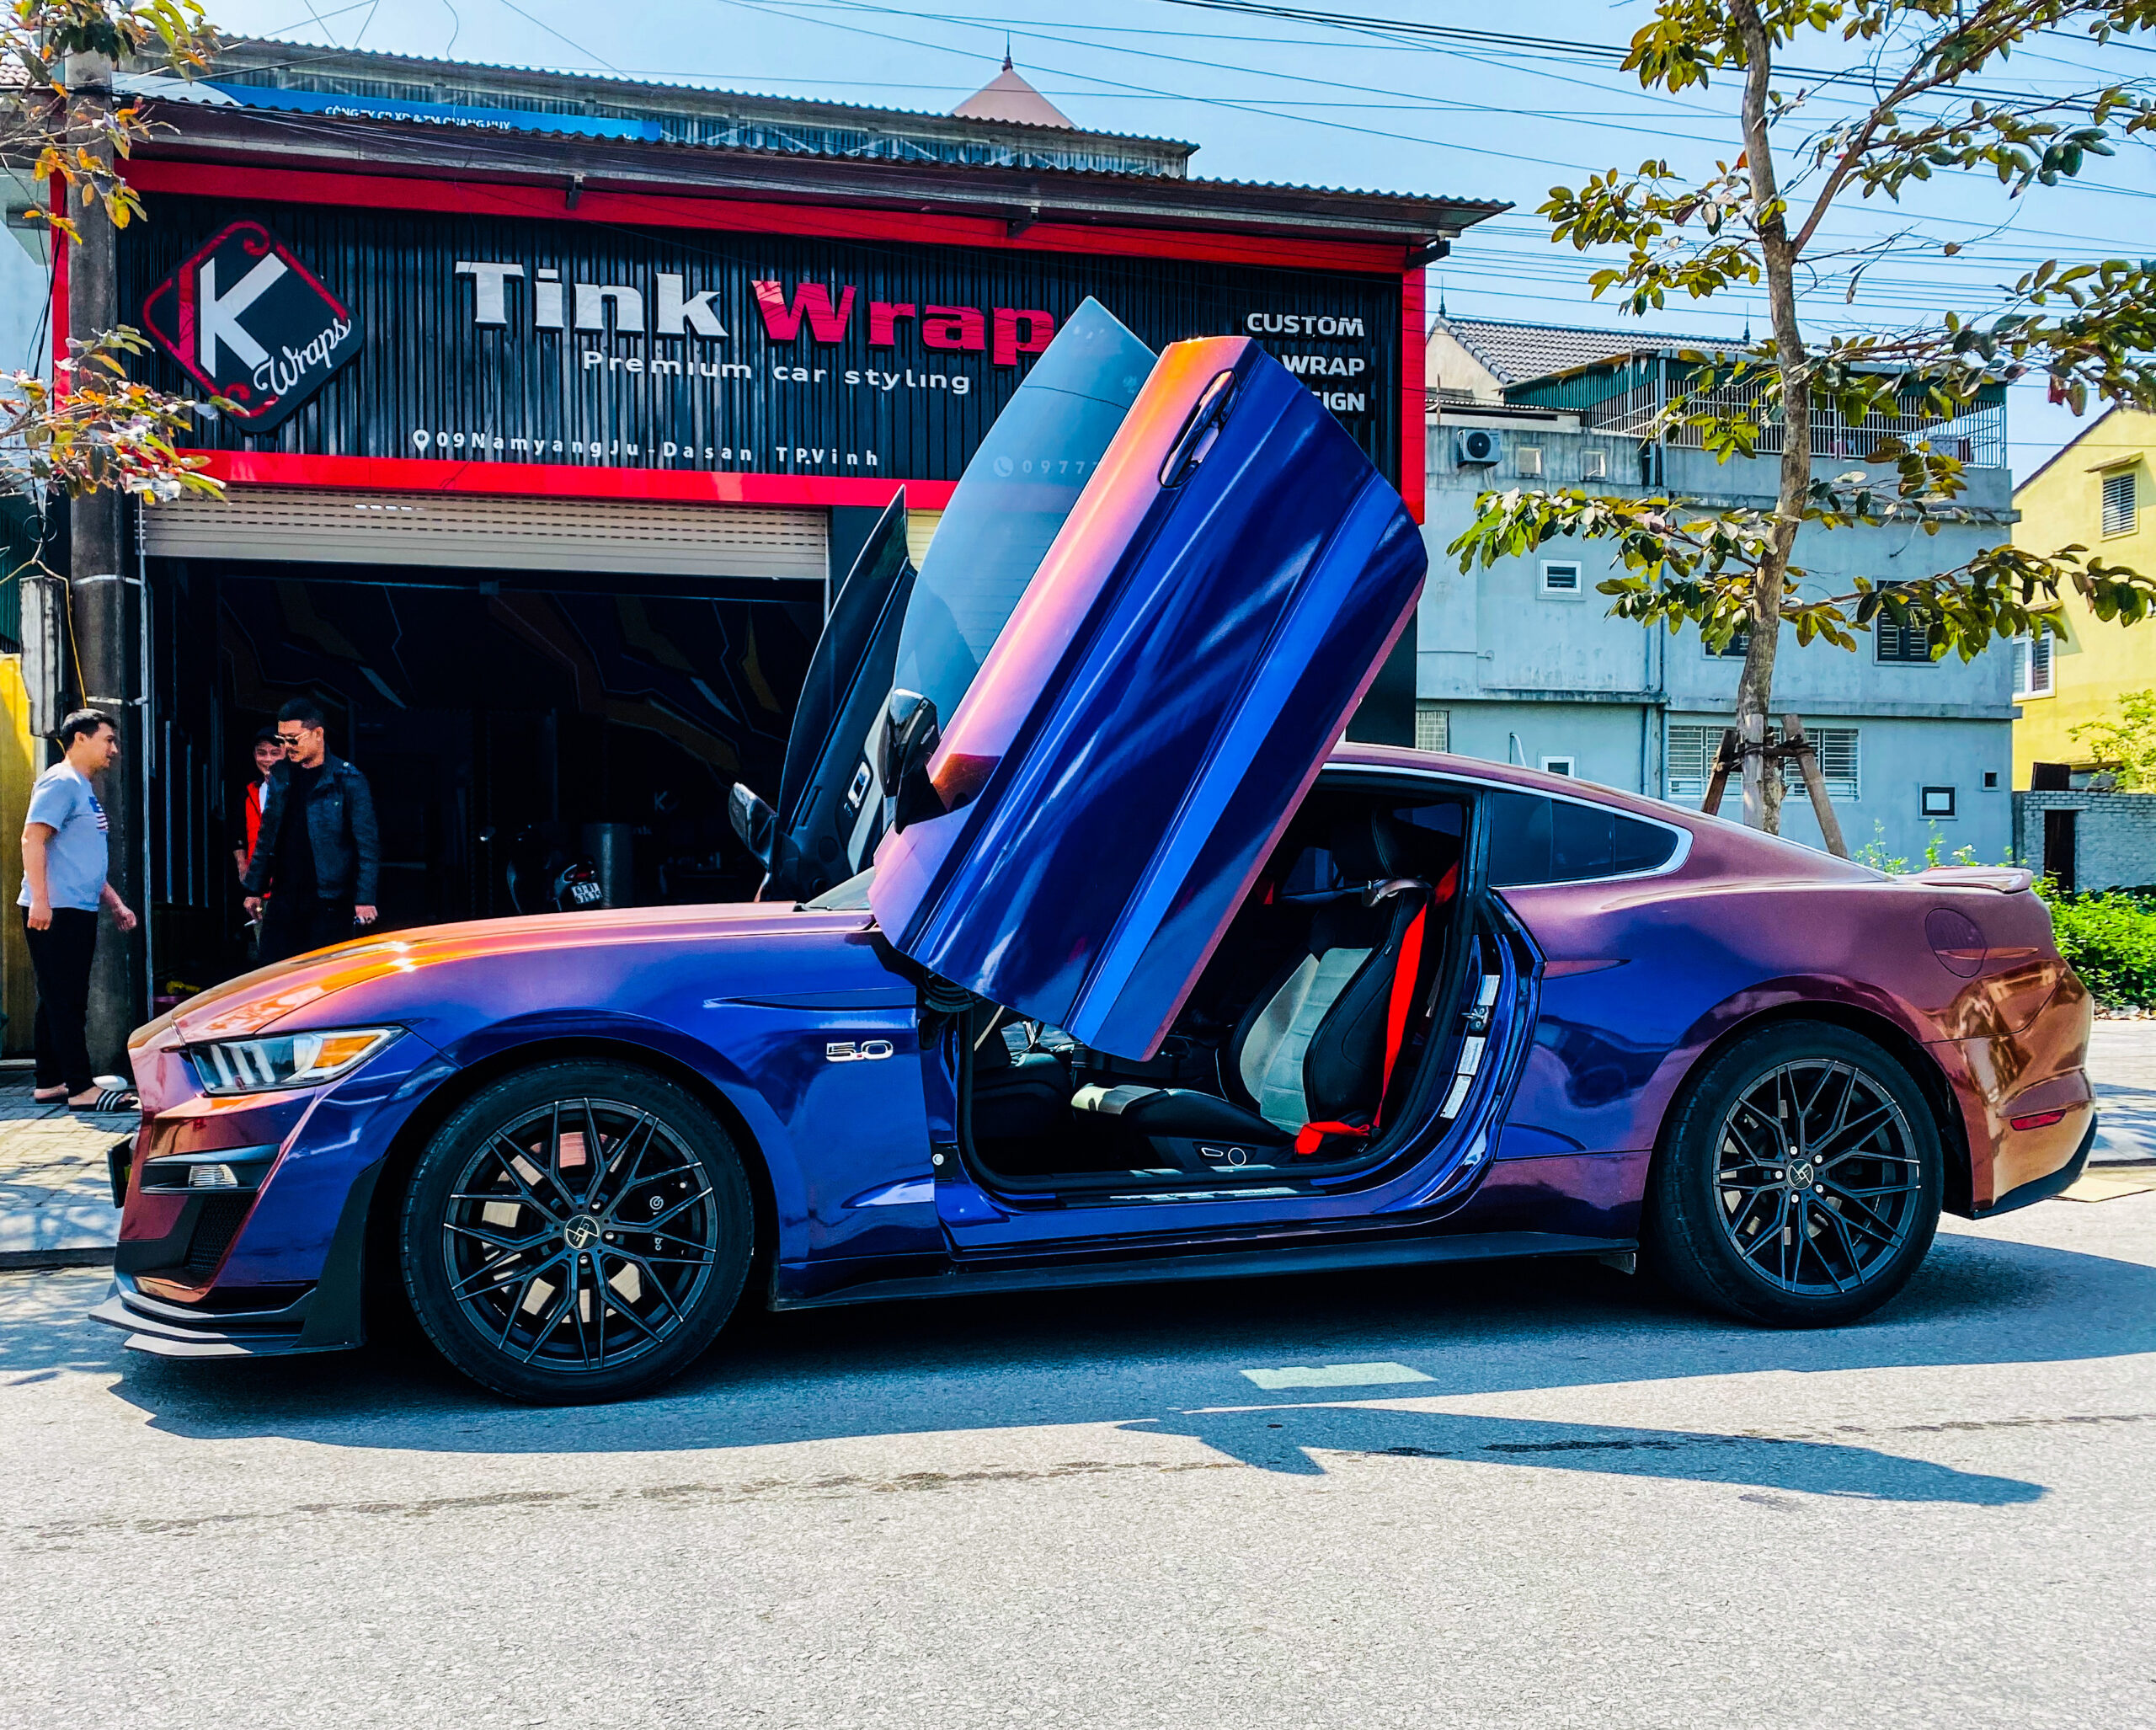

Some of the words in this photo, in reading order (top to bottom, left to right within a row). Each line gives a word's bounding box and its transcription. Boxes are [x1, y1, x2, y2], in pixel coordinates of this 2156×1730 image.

[455, 260, 729, 337] Tink
[750, 280, 1070, 366] Wrap
[1247, 312, 1365, 337] CUSTOM
[253, 318, 351, 395] Wraps
[1281, 355, 1365, 376] WRAP
[583, 350, 752, 379] Premium
[772, 364, 827, 382] car
[844, 368, 970, 395] styling
[1311, 391, 1365, 412] IGN
[1022, 460, 1098, 475] 0977
[826, 1039, 894, 1062] 5.0
